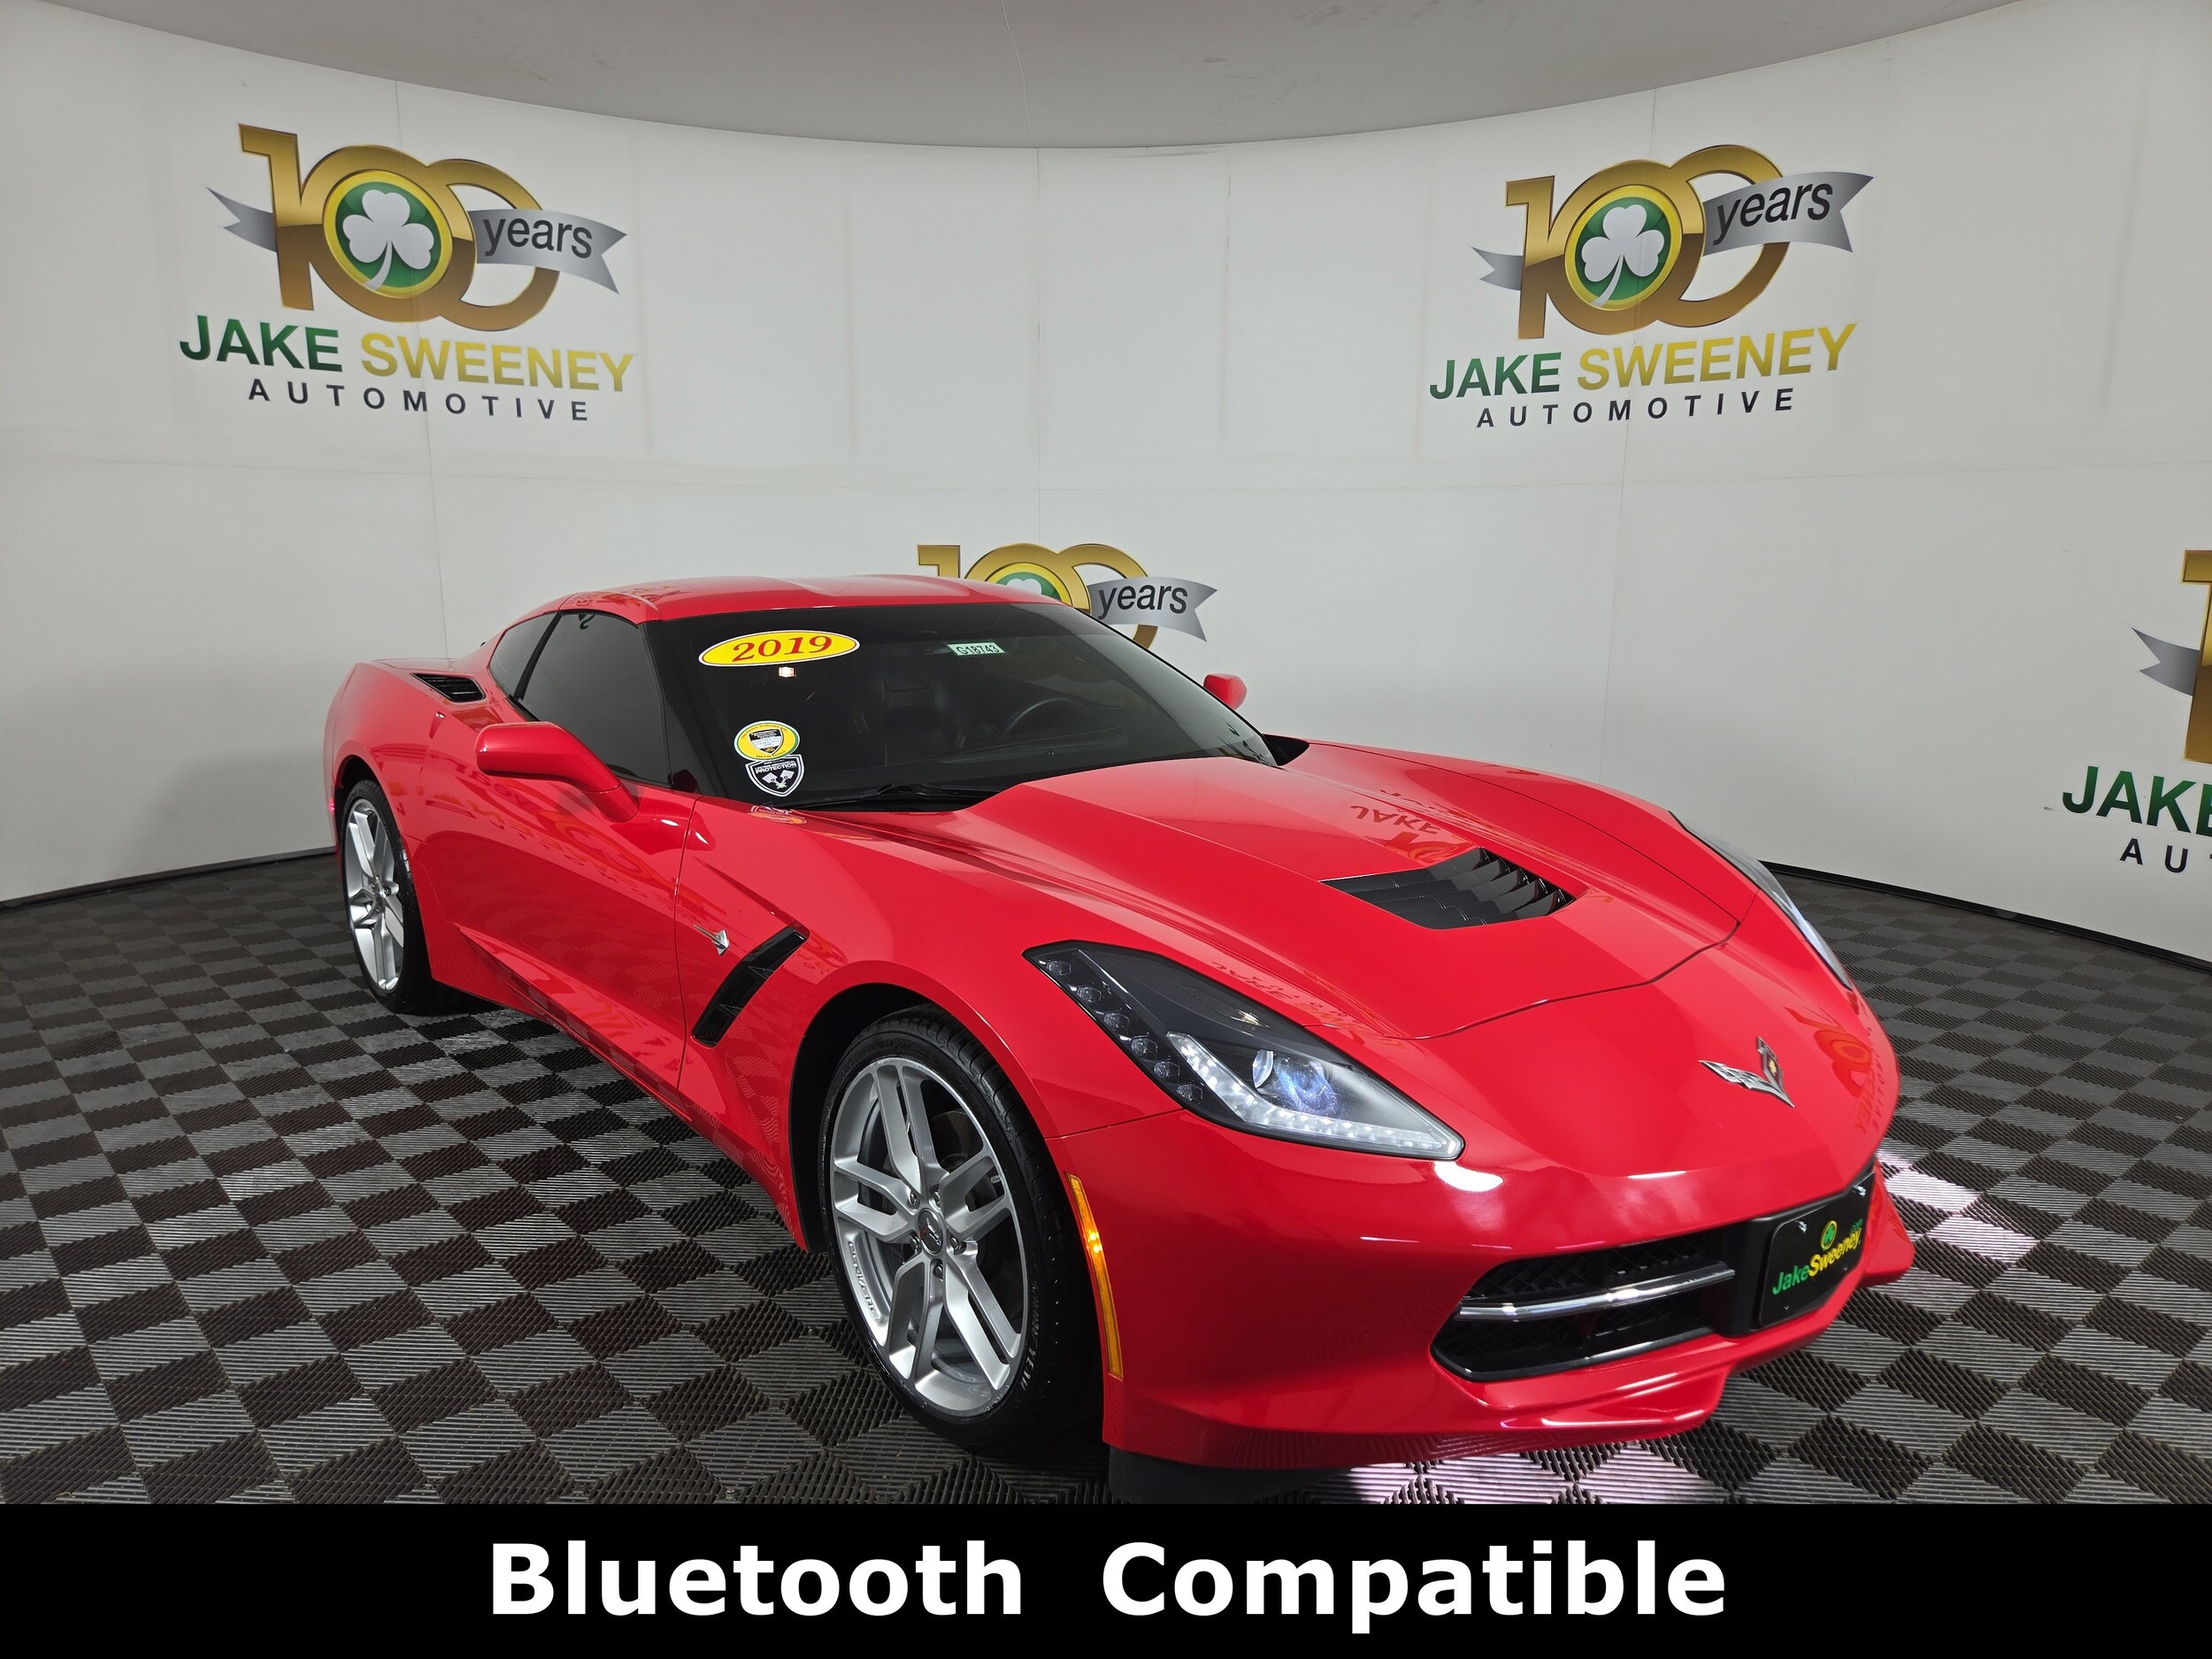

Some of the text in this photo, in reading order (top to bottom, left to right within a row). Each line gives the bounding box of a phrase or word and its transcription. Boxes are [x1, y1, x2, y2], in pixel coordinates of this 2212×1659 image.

[1712, 181, 1833, 247] years
[482, 214, 593, 259] years
[179, 314, 634, 393] JAKE SWEENEY
[1429, 322, 1857, 400] JAKE SWEENEY
[249, 378, 588, 422] AUTOMOTIVE
[1477, 388, 1794, 429] AUTOMOTIVE
[1097, 584, 1188, 620] years
[733, 635, 833, 662] 2019
[956, 644, 1000, 656] G18743
